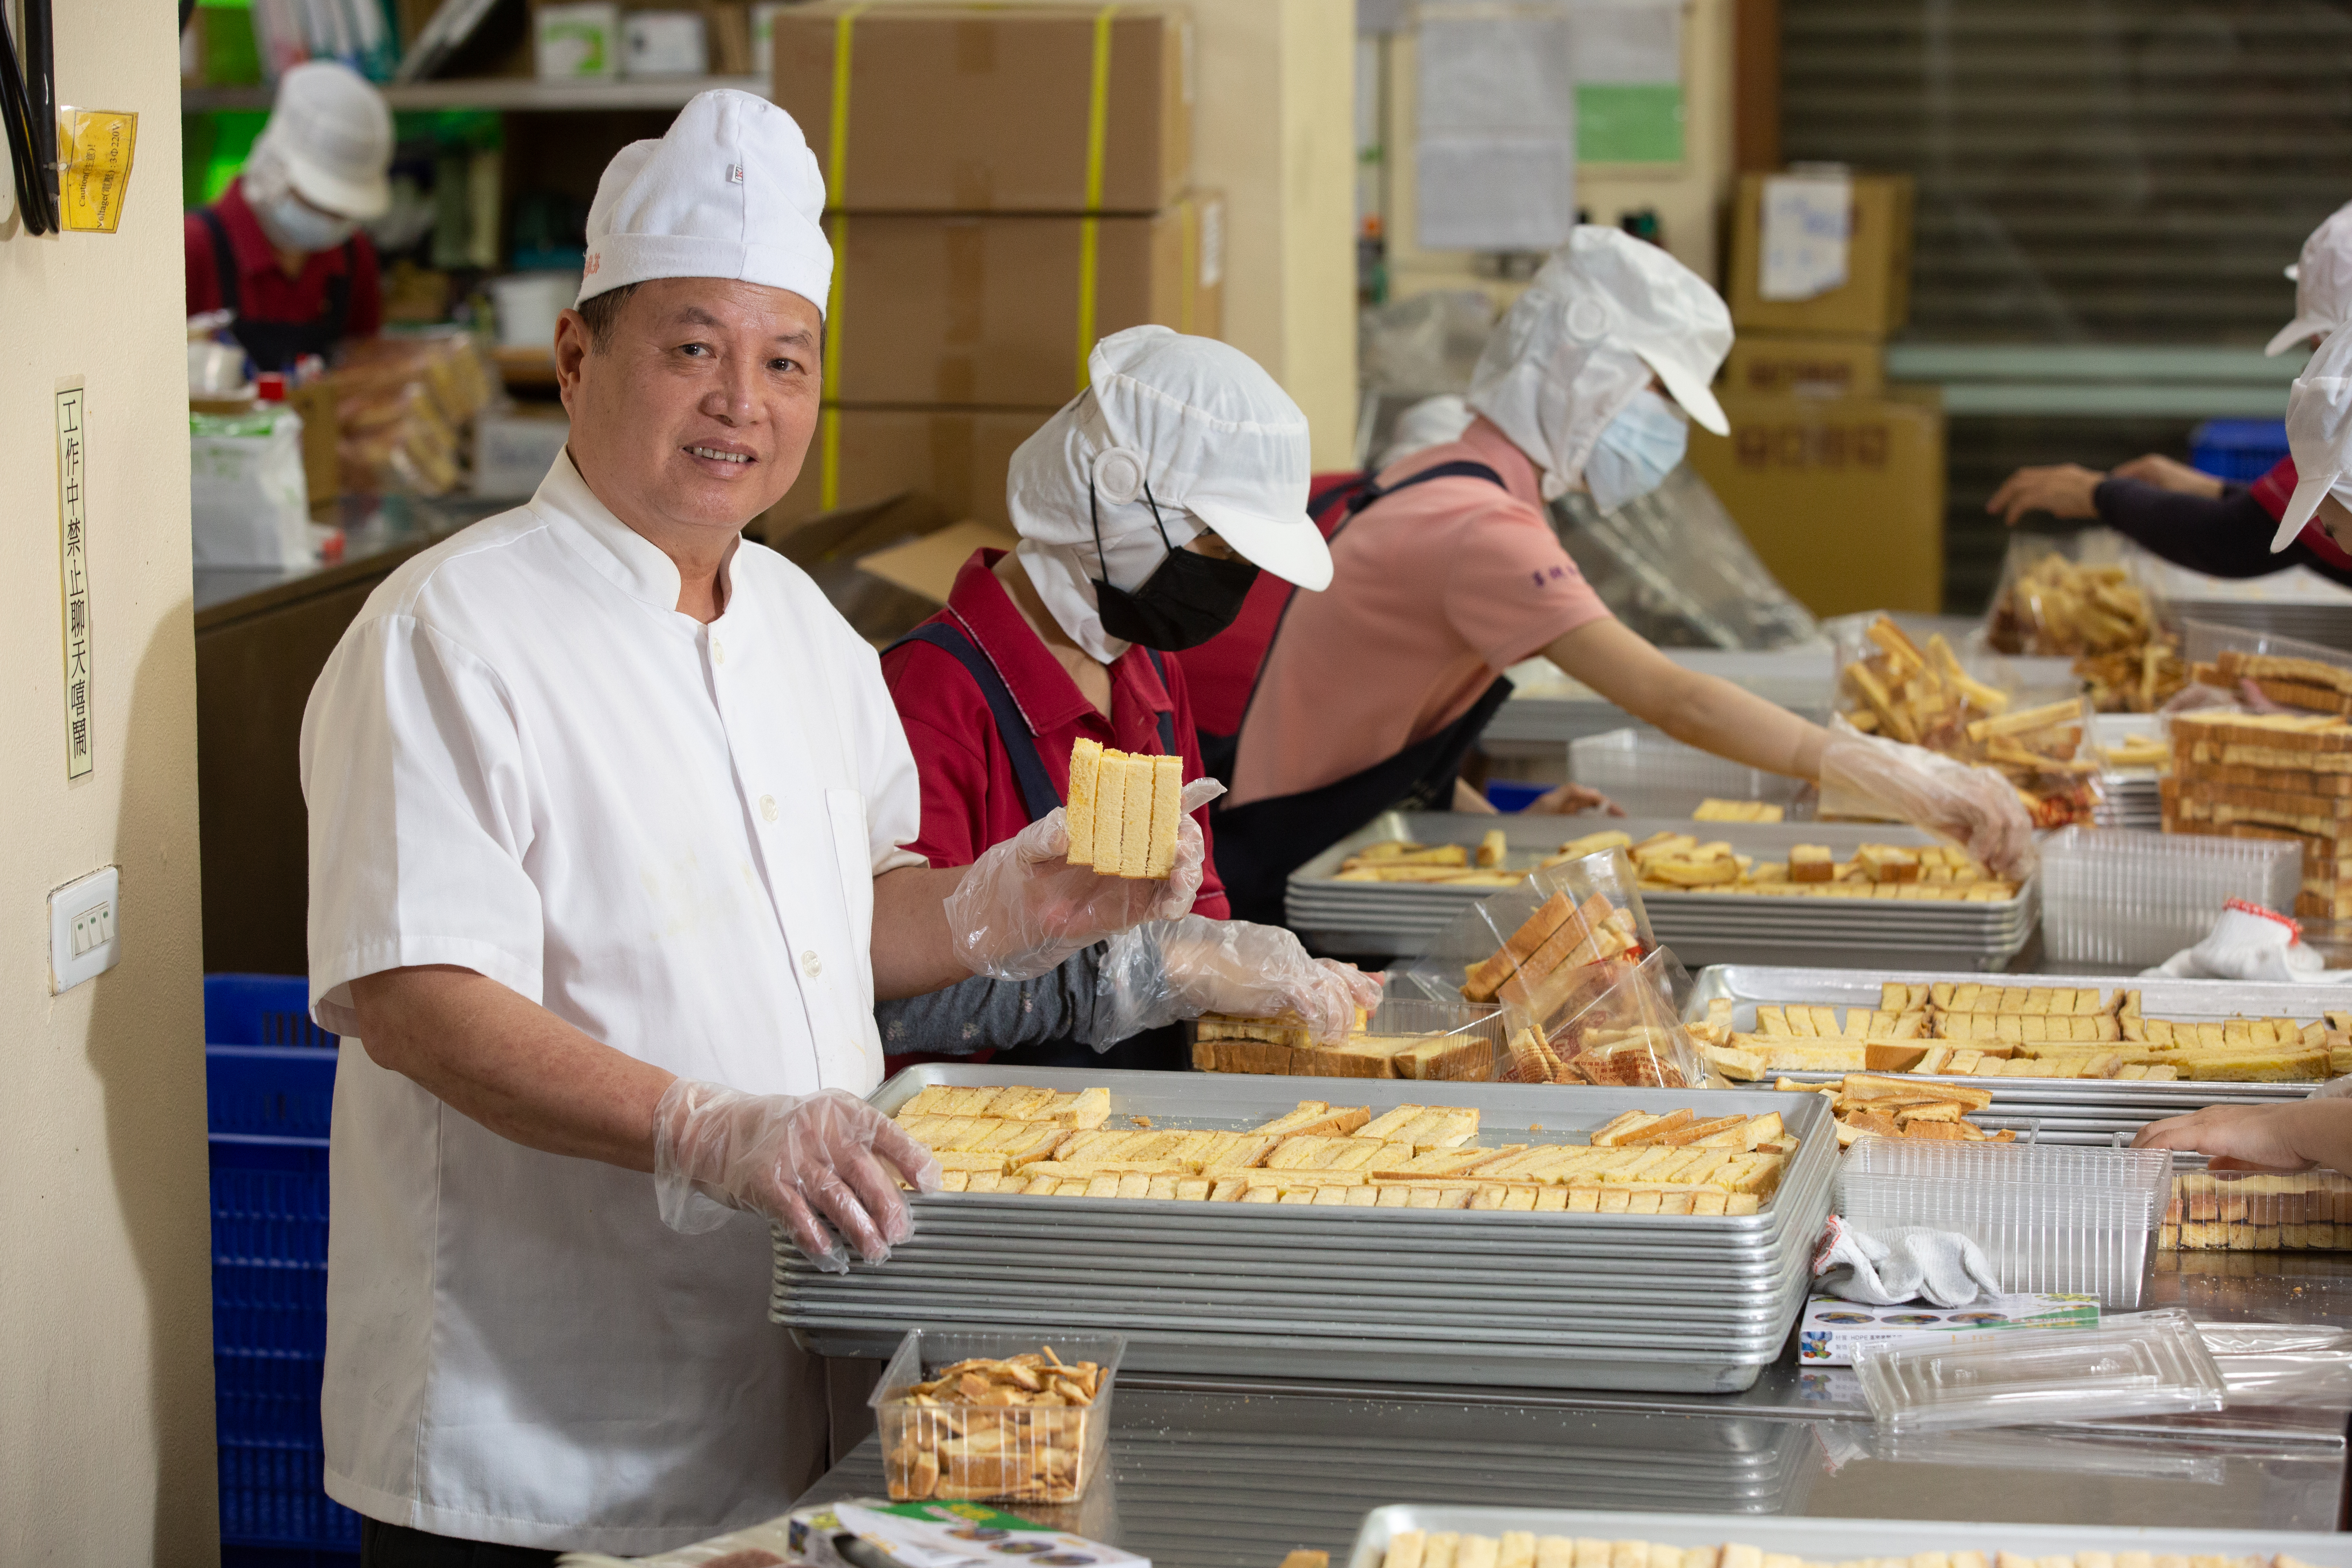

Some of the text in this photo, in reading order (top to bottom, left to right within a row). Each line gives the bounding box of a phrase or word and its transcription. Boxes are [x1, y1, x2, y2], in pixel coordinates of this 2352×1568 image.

[62, 399, 86, 759] 工作中禁止聊天嘻鬧
